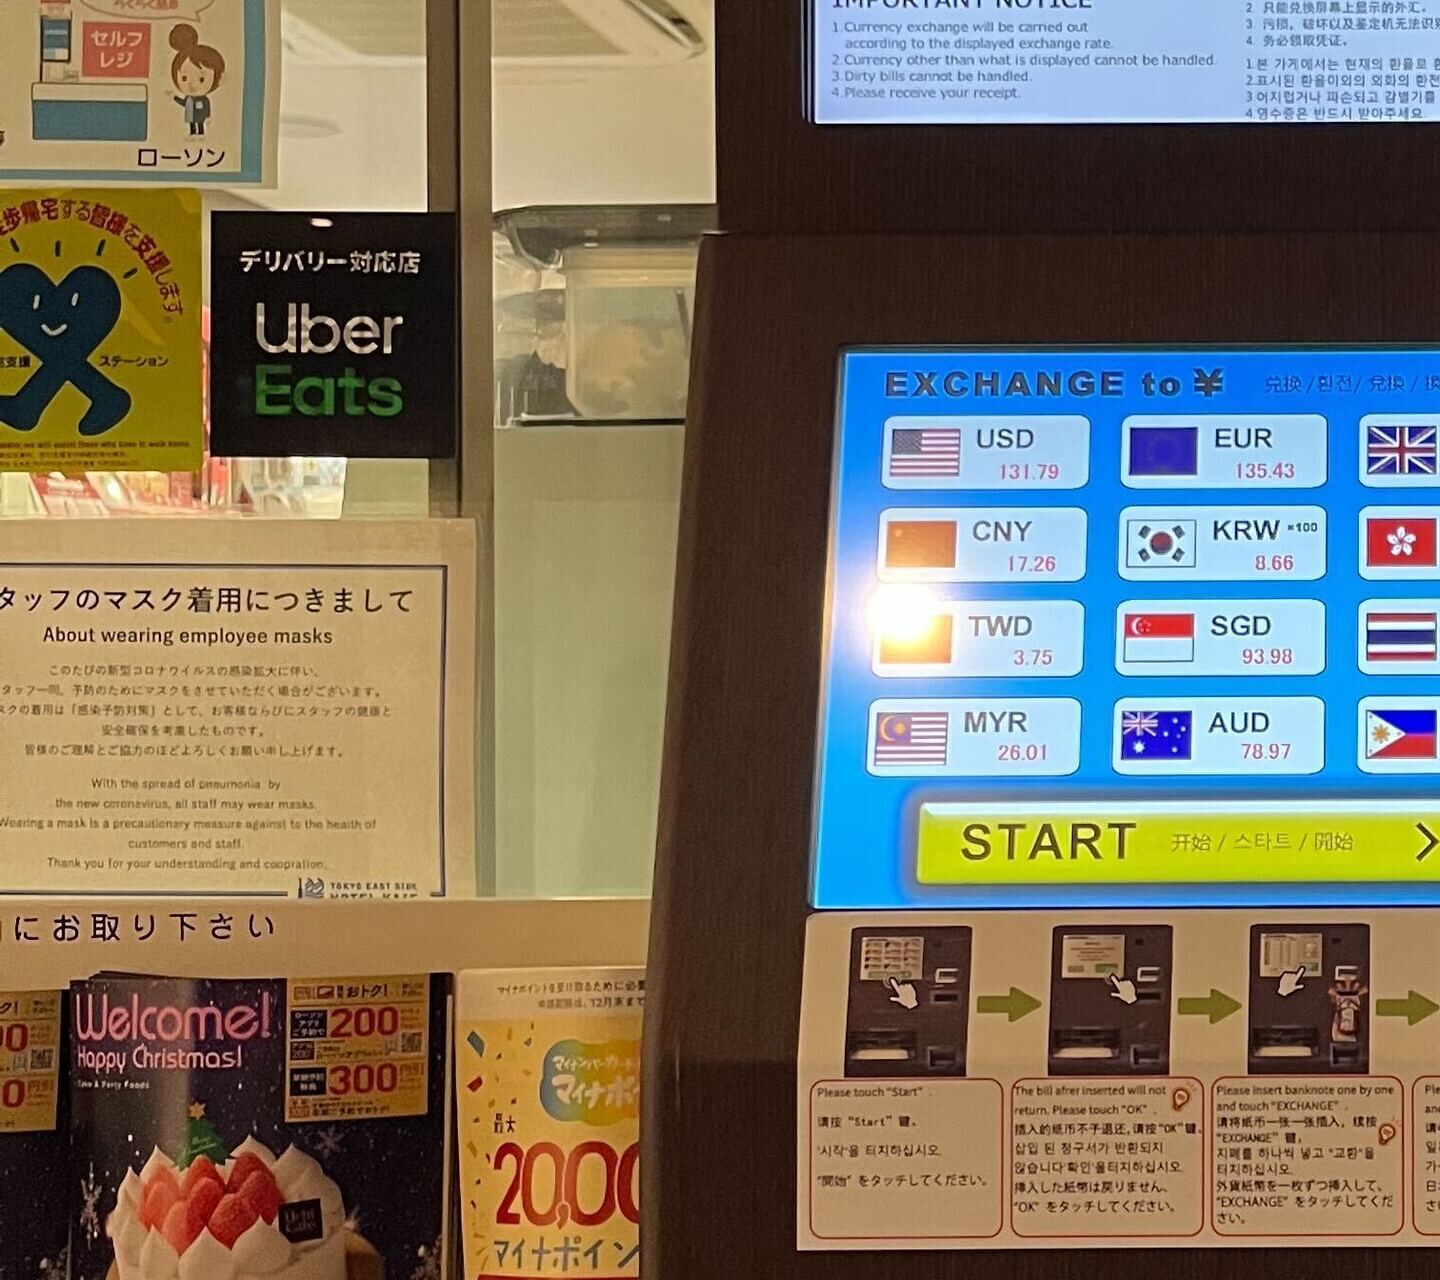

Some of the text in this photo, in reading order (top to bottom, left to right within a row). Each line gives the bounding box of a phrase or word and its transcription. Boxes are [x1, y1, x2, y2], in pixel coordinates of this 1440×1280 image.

[91, 30, 144, 47] セルフ
[832, 21, 1088, 35] 1.Currency exchange will be carried out
[845, 37, 1113, 51] according to the displayed exchange rate.
[100, 50, 134, 69] レジ
[832, 70, 1033, 83] 3.Dirty bills cannot be handled.
[832, 87, 1021, 100] 4.Please receive your receipt.
[138, 147, 226, 169] ローソン
[0, 198, 184, 324] 歩帰宅する皆様を支援します。
[239, 250, 421, 274] デリバリー対応店
[255, 301, 404, 355] Uber
[100, 355, 169, 368] ステーション
[254, 363, 403, 417] Eats
[884, 367, 1224, 398] EXCHANGE to ¥
[976, 428, 1035, 450] USD
[1215, 427, 1273, 449] EUR
[1000, 463, 1060, 481] 131.79
[1236, 462, 1295, 480] 135.43
[972, 520, 1033, 543] CNY
[1213, 519, 1281, 541] KRW
[1008, 555, 1057, 573] 17.26
[1255, 554, 1294, 572] 8.66
[43, 626, 333, 647] About wearing employee masks
[968, 615, 1033, 637] TWD
[1210, 614, 1272, 637] SGD
[1013, 649, 1054, 666] 3.75
[1242, 648, 1294, 665] 93.98
[964, 711, 1028, 734] MYR
[1208, 712, 1271, 734] AUD
[998, 744, 1048, 762] 26.01
[1241, 743, 1292, 760] 78.97
[960, 822, 1137, 862] START
[1233, 833, 1293, 851] 스타트
[0, 913, 275, 943] にお取り下さい
[75, 991, 272, 1041] Welcome!
[329, 1006, 399, 1038] 200
[77, 1043, 242, 1074] Happy Christmas!
[328, 1062, 398, 1096] 300
[817, 1086, 923, 1097] Please touch “Start”
